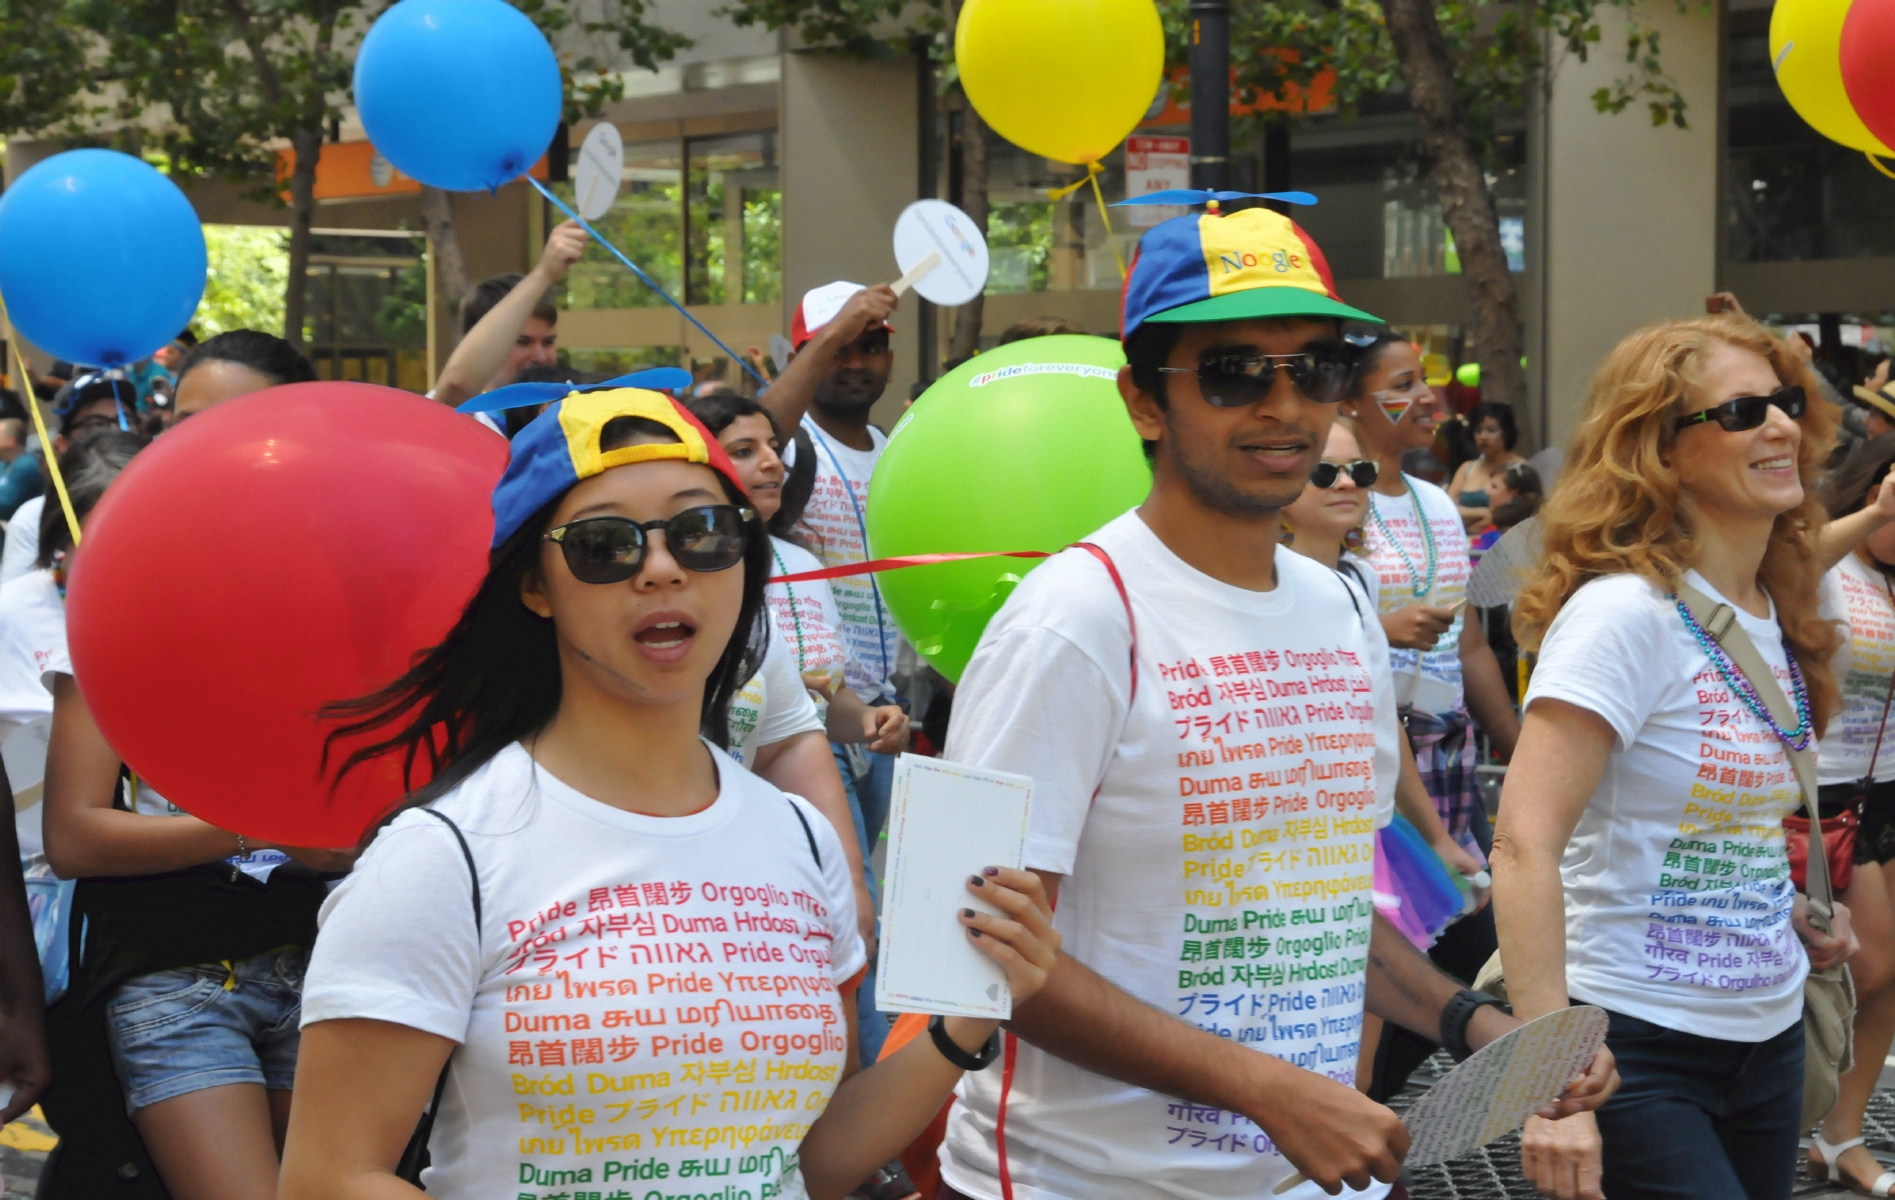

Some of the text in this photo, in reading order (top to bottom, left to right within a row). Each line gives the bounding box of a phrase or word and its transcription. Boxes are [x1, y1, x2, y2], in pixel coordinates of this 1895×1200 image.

[1168, 684, 1213, 710] Bród
[1215, 677, 1268, 704] 자부심
[1266, 679, 1308, 698] Duma
[1696, 688, 1729, 704] Bród
[1175, 710, 1249, 739] プライド
[1304, 701, 1345, 723] Pride
[1267, 734, 1303, 756] Pride
[1699, 743, 1751, 765] Duma
[1179, 776, 1244, 797] Duma
[1697, 763, 1765, 788] 昂首闊步
[1690, 782, 1737, 805] Bród
[1182, 796, 1270, 826] 昂首闊步
[1272, 791, 1308, 815] Pride
[1684, 802, 1734, 823] Pride
[1182, 829, 1234, 853] Bród
[1282, 814, 1328, 842] 자부심
[1669, 838, 1717, 853] Duma
[1722, 840, 1756, 857] Pride
[1183, 857, 1246, 879] Pride
[1306, 843, 1359, 868] גאווה
[1662, 851, 1737, 876] 昂首闊步
[1660, 872, 1700, 890] Bród
[507, 901, 577, 942] Pride
[587, 881, 693, 912] 昂首闊步
[701, 881, 789, 908] Orgoglio
[578, 911, 657, 940] 자부심
[662, 913, 728, 934] Duma
[733, 911, 800, 935] Hrdost
[1183, 913, 1238, 934] Duma
[1242, 908, 1287, 930] Pride
[1179, 936, 1271, 963] 昂首闊步
[1275, 930, 1341, 959] Orgoglio
[1646, 922, 1722, 947] 昂首闊步
[630, 942, 713, 965] גאווה
[722, 941, 785, 963] Pride
[1644, 940, 1690, 964] गौरव
[1697, 952, 1743, 968] Pride
[555, 970, 638, 999] ไพรด
[647, 971, 713, 994] Pride
[1178, 965, 1225, 989] Bród
[1230, 961, 1285, 989] 자부심
[1645, 964, 1714, 986] プライド
[1177, 991, 1265, 1018] プライド
[1267, 990, 1317, 1014] Pride
[505, 1011, 591, 1033] Duma
[601, 1008, 667, 1028] சுய
[508, 1028, 845, 1067] 昂首闊步 Pride Orgoglio
[511, 1057, 838, 1096] Bród Duma 자부심 Hrdost
[518, 1103, 595, 1125] Pride
[604, 1093, 712, 1124] プライド
[719, 1088, 798, 1112] גאווה
[567, 1125, 641, 1156] ไพรด
[1166, 1125, 1248, 1152] プライド
[519, 1162, 593, 1187] Duma
[603, 1157, 670, 1183] Pride
[678, 1157, 731, 1178] சுய
